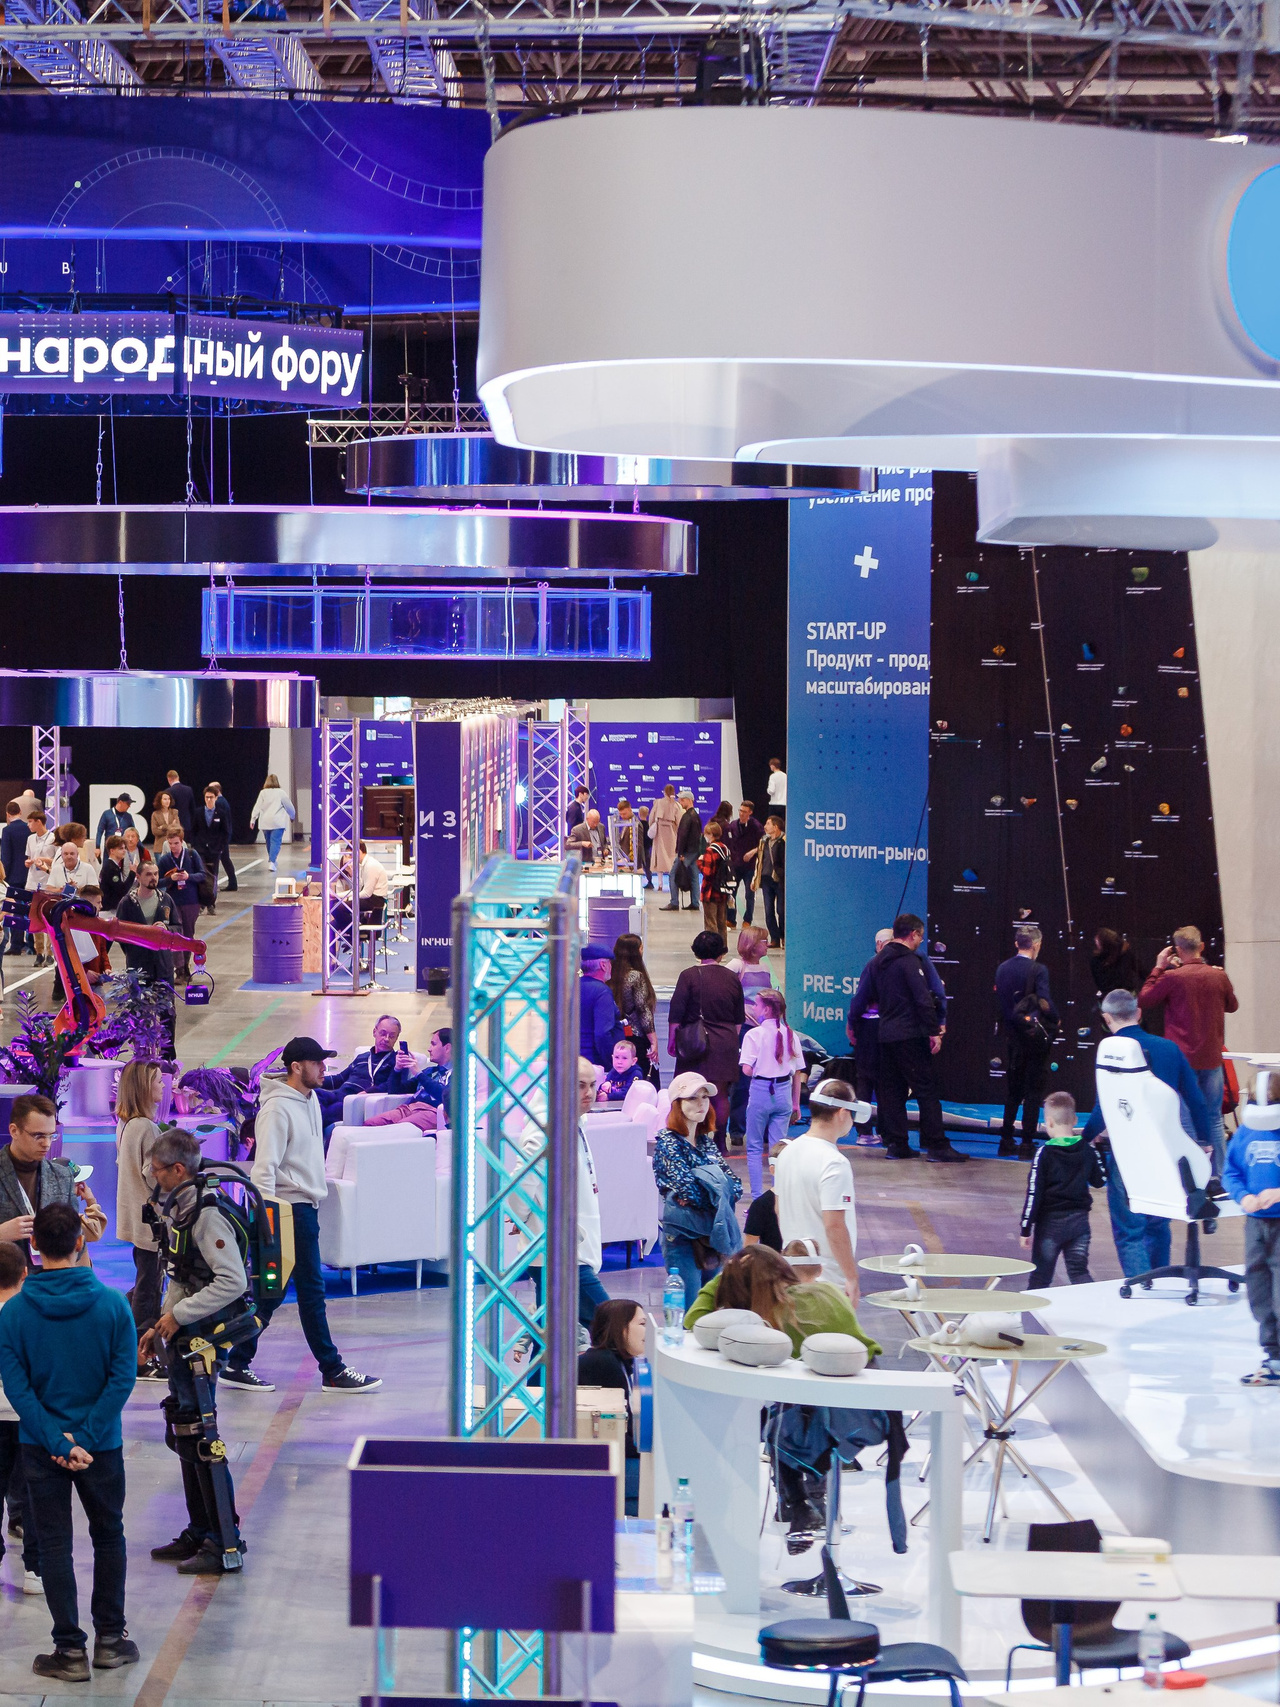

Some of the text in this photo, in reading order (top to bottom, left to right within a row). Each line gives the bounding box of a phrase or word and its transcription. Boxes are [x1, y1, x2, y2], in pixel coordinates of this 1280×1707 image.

[272, 335, 363, 397] фору
[806, 622, 887, 640] START-UP
[806, 649, 872, 672] Продукт
[888, 654, 931, 672] прод
[806, 676, 930, 700] масштабирован
[804, 812, 846, 830] SEED
[804, 839, 928, 864] Прототип-рыно
[803, 1001, 844, 1022] Идея
